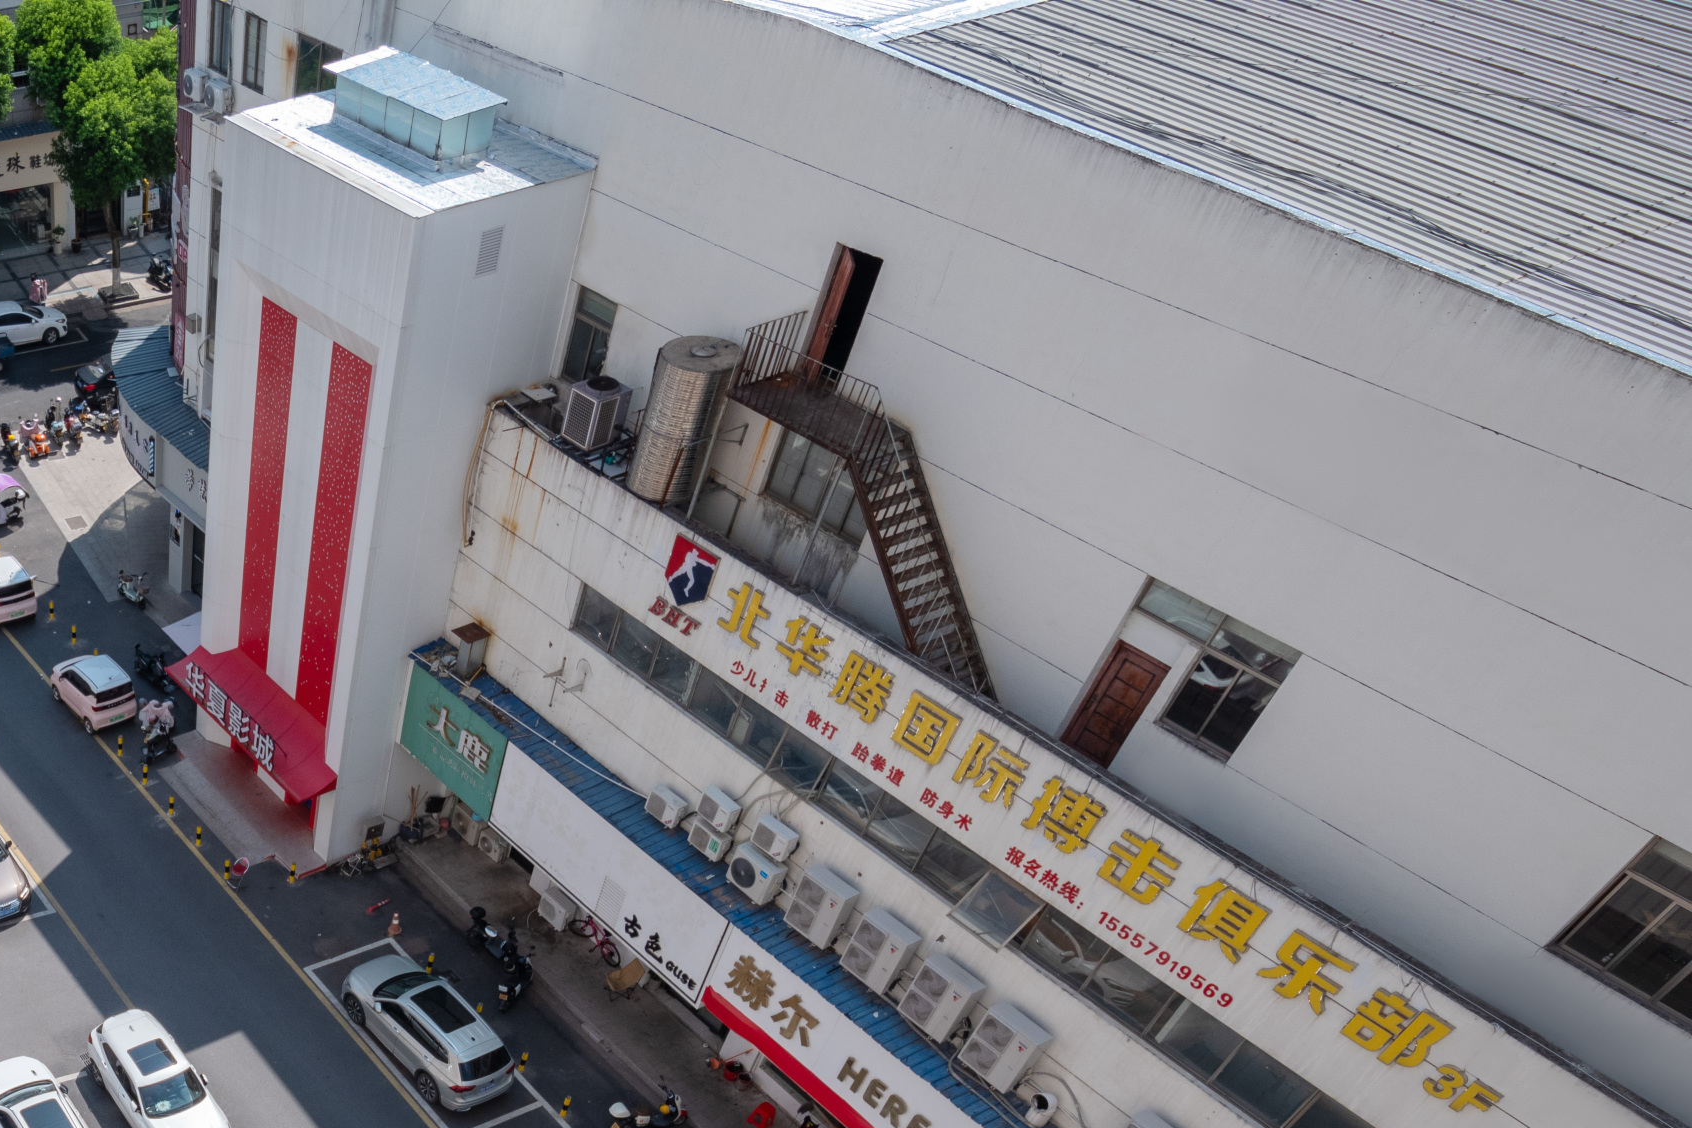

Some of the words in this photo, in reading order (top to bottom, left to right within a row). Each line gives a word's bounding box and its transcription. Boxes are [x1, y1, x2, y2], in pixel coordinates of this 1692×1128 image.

[648, 595, 702, 636] BHT
[184, 661, 276, 773] 华夏影城
[716, 582, 1456, 1067] 北华腾国际搏击俱乐部
[1422, 1064, 1505, 1112] 3F
[805, 709, 839, 741] 散打
[850, 741, 906, 787] 跆拳道
[919, 787, 974, 831] 防身术
[1097, 910, 1234, 1008] 15557919569
[624, 914, 663, 965] 古色
[724, 954, 820, 1048] 赫尔
